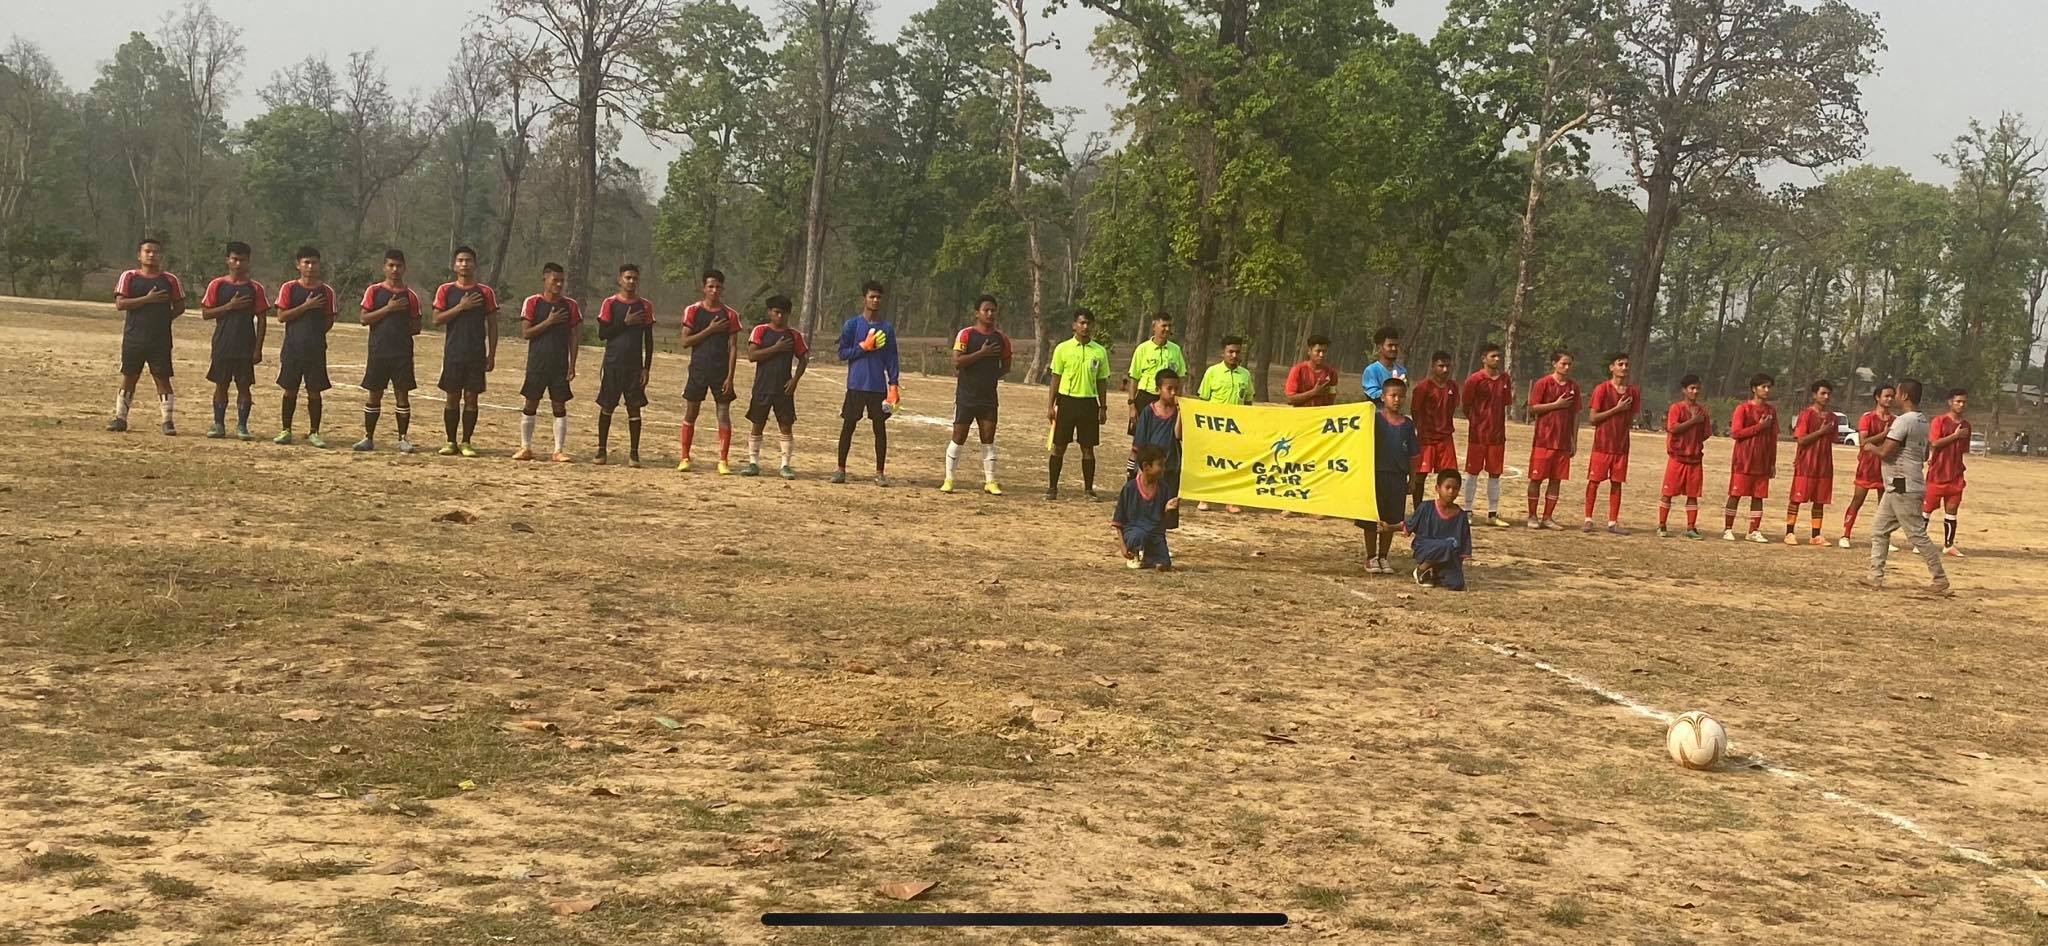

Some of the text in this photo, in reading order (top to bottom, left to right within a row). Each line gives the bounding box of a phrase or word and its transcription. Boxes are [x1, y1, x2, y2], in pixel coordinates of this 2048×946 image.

[1195, 414, 1241, 434] FIFA
[1322, 416, 1360, 433] AFC
[1206, 455, 1348, 474] MY GAME IS
[1256, 474, 1301, 485] FAIR
[1256, 488, 1311, 499] PLAY
